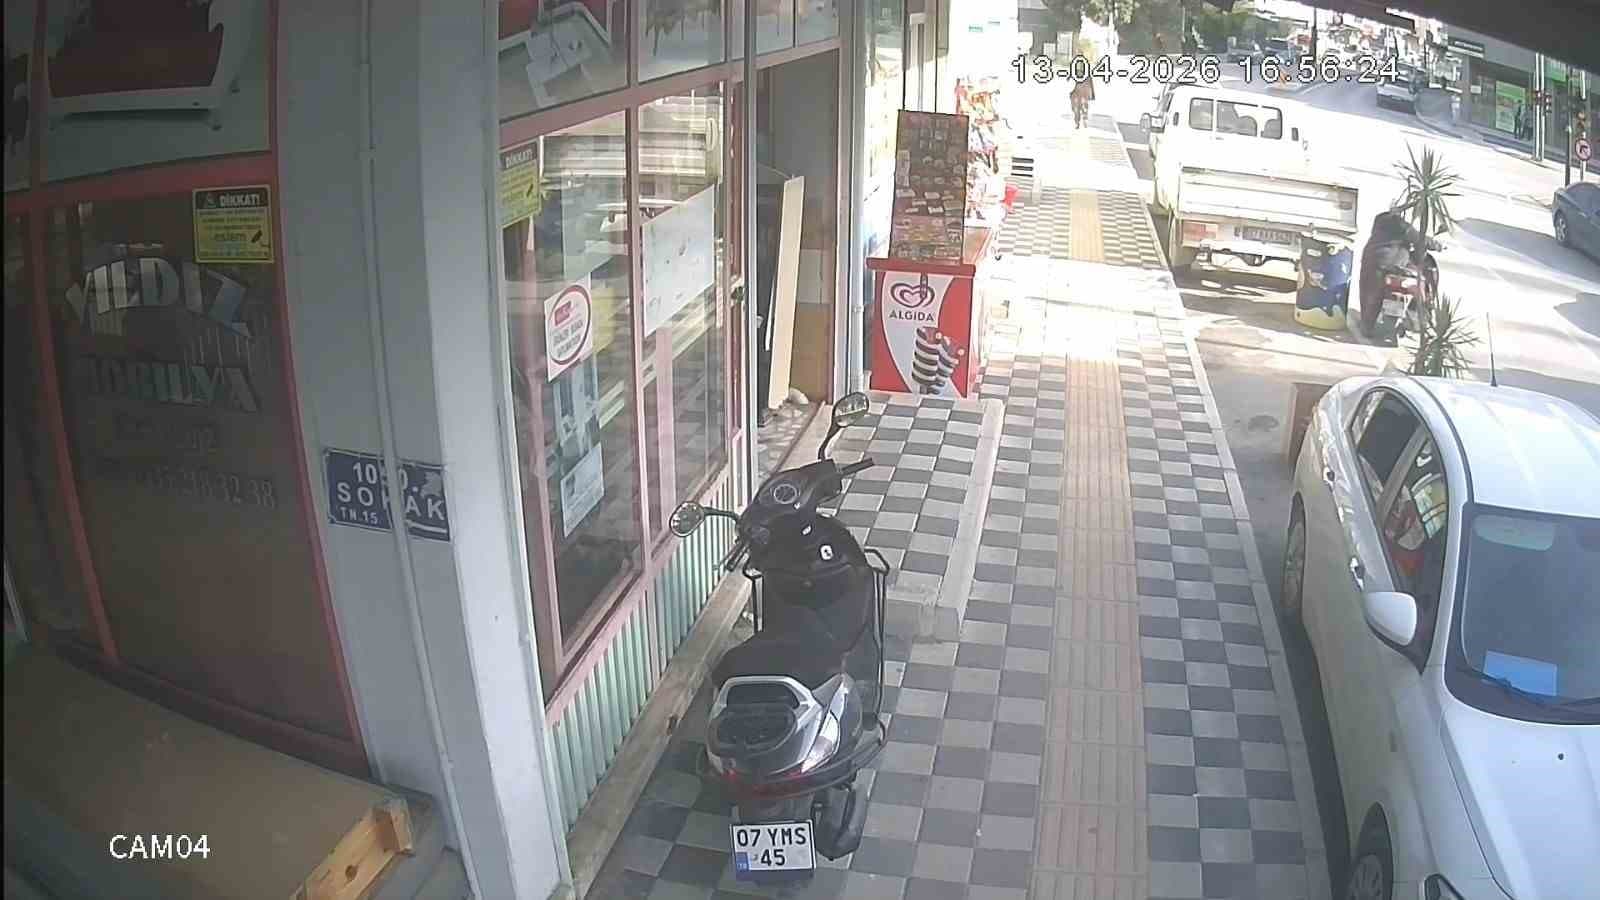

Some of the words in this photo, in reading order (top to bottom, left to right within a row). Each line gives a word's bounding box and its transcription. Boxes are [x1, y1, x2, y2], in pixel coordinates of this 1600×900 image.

[736, 828, 761, 847] 07
[767, 827, 807, 846] YMS
[760, 848, 786, 867] 45
